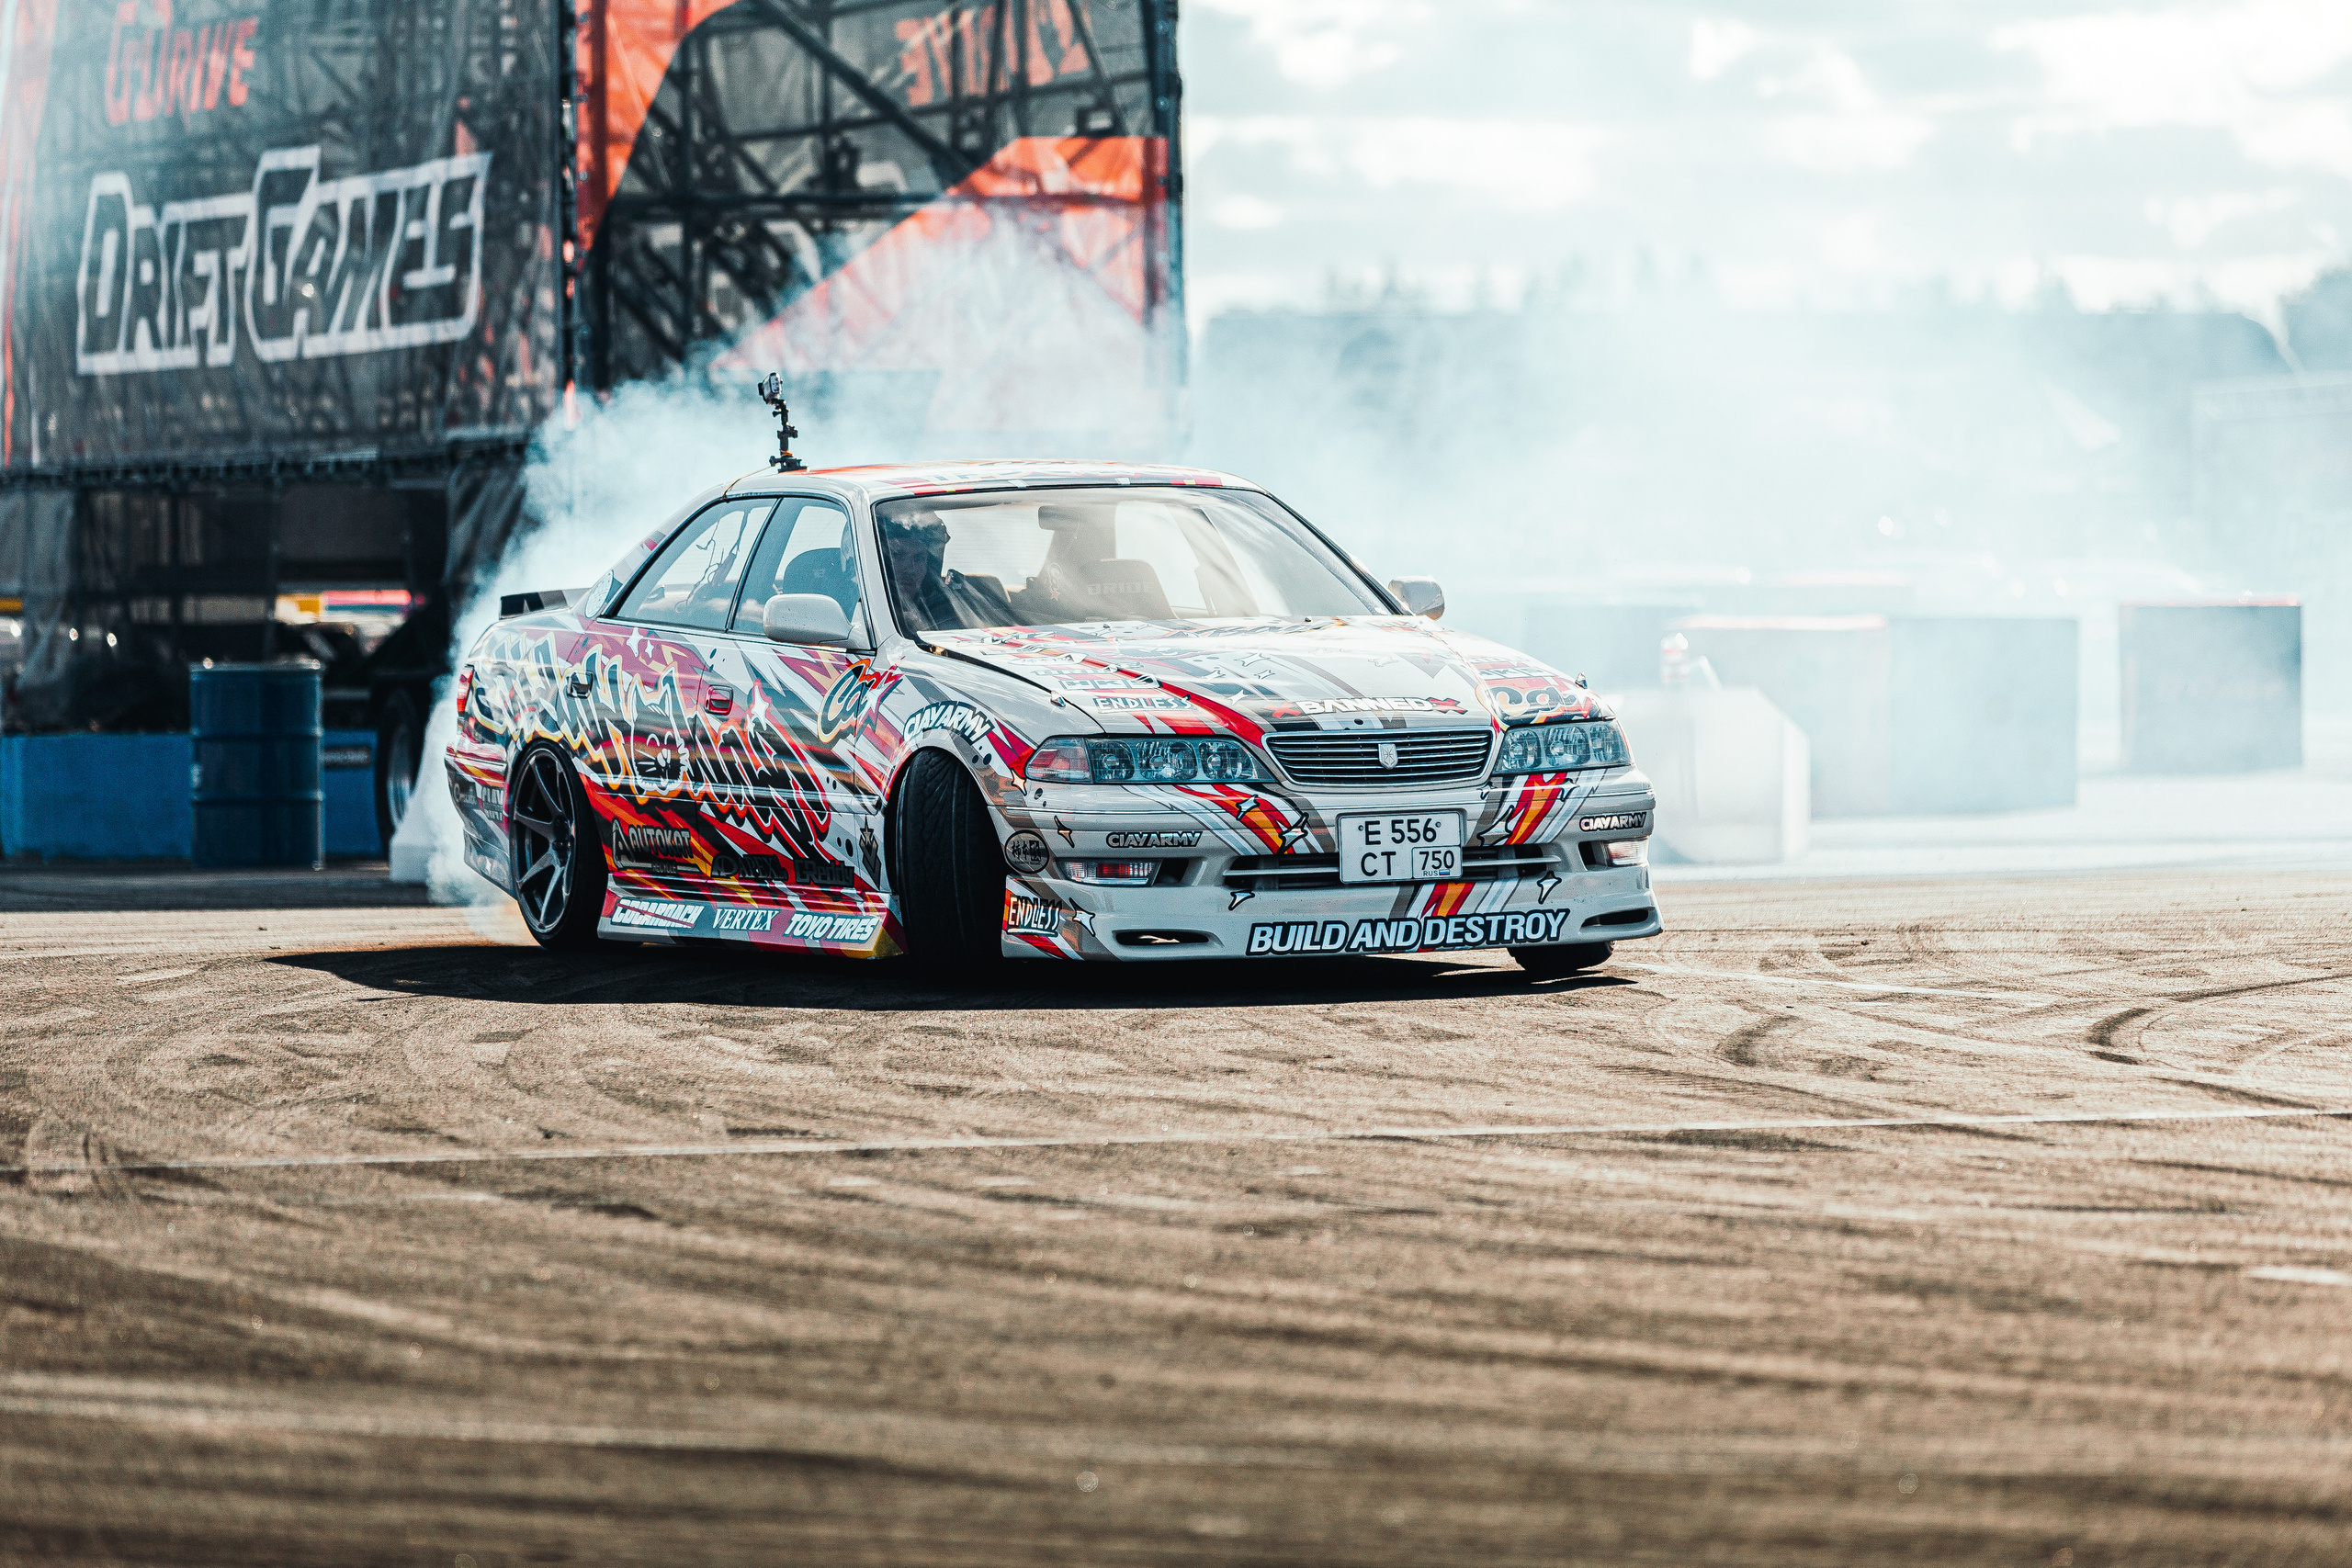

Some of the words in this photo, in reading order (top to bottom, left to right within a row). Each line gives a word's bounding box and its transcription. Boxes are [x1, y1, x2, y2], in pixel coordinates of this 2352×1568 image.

[1097, 696, 1193, 712] ENDLESS
[1364, 820, 1381, 845] E
[1391, 818, 1437, 844] 556
[1361, 851, 1396, 876] CT
[1419, 850, 1454, 870] 750
[712, 908, 779, 931] VERTEX
[784, 913, 834, 939] TOYO
[827, 918, 880, 941] TIRES
[1008, 897, 1060, 931] ENDLESS
[1250, 922, 1346, 953] BUILD
[1350, 920, 1420, 950] AND
[1423, 912, 1567, 946] DESTROY
